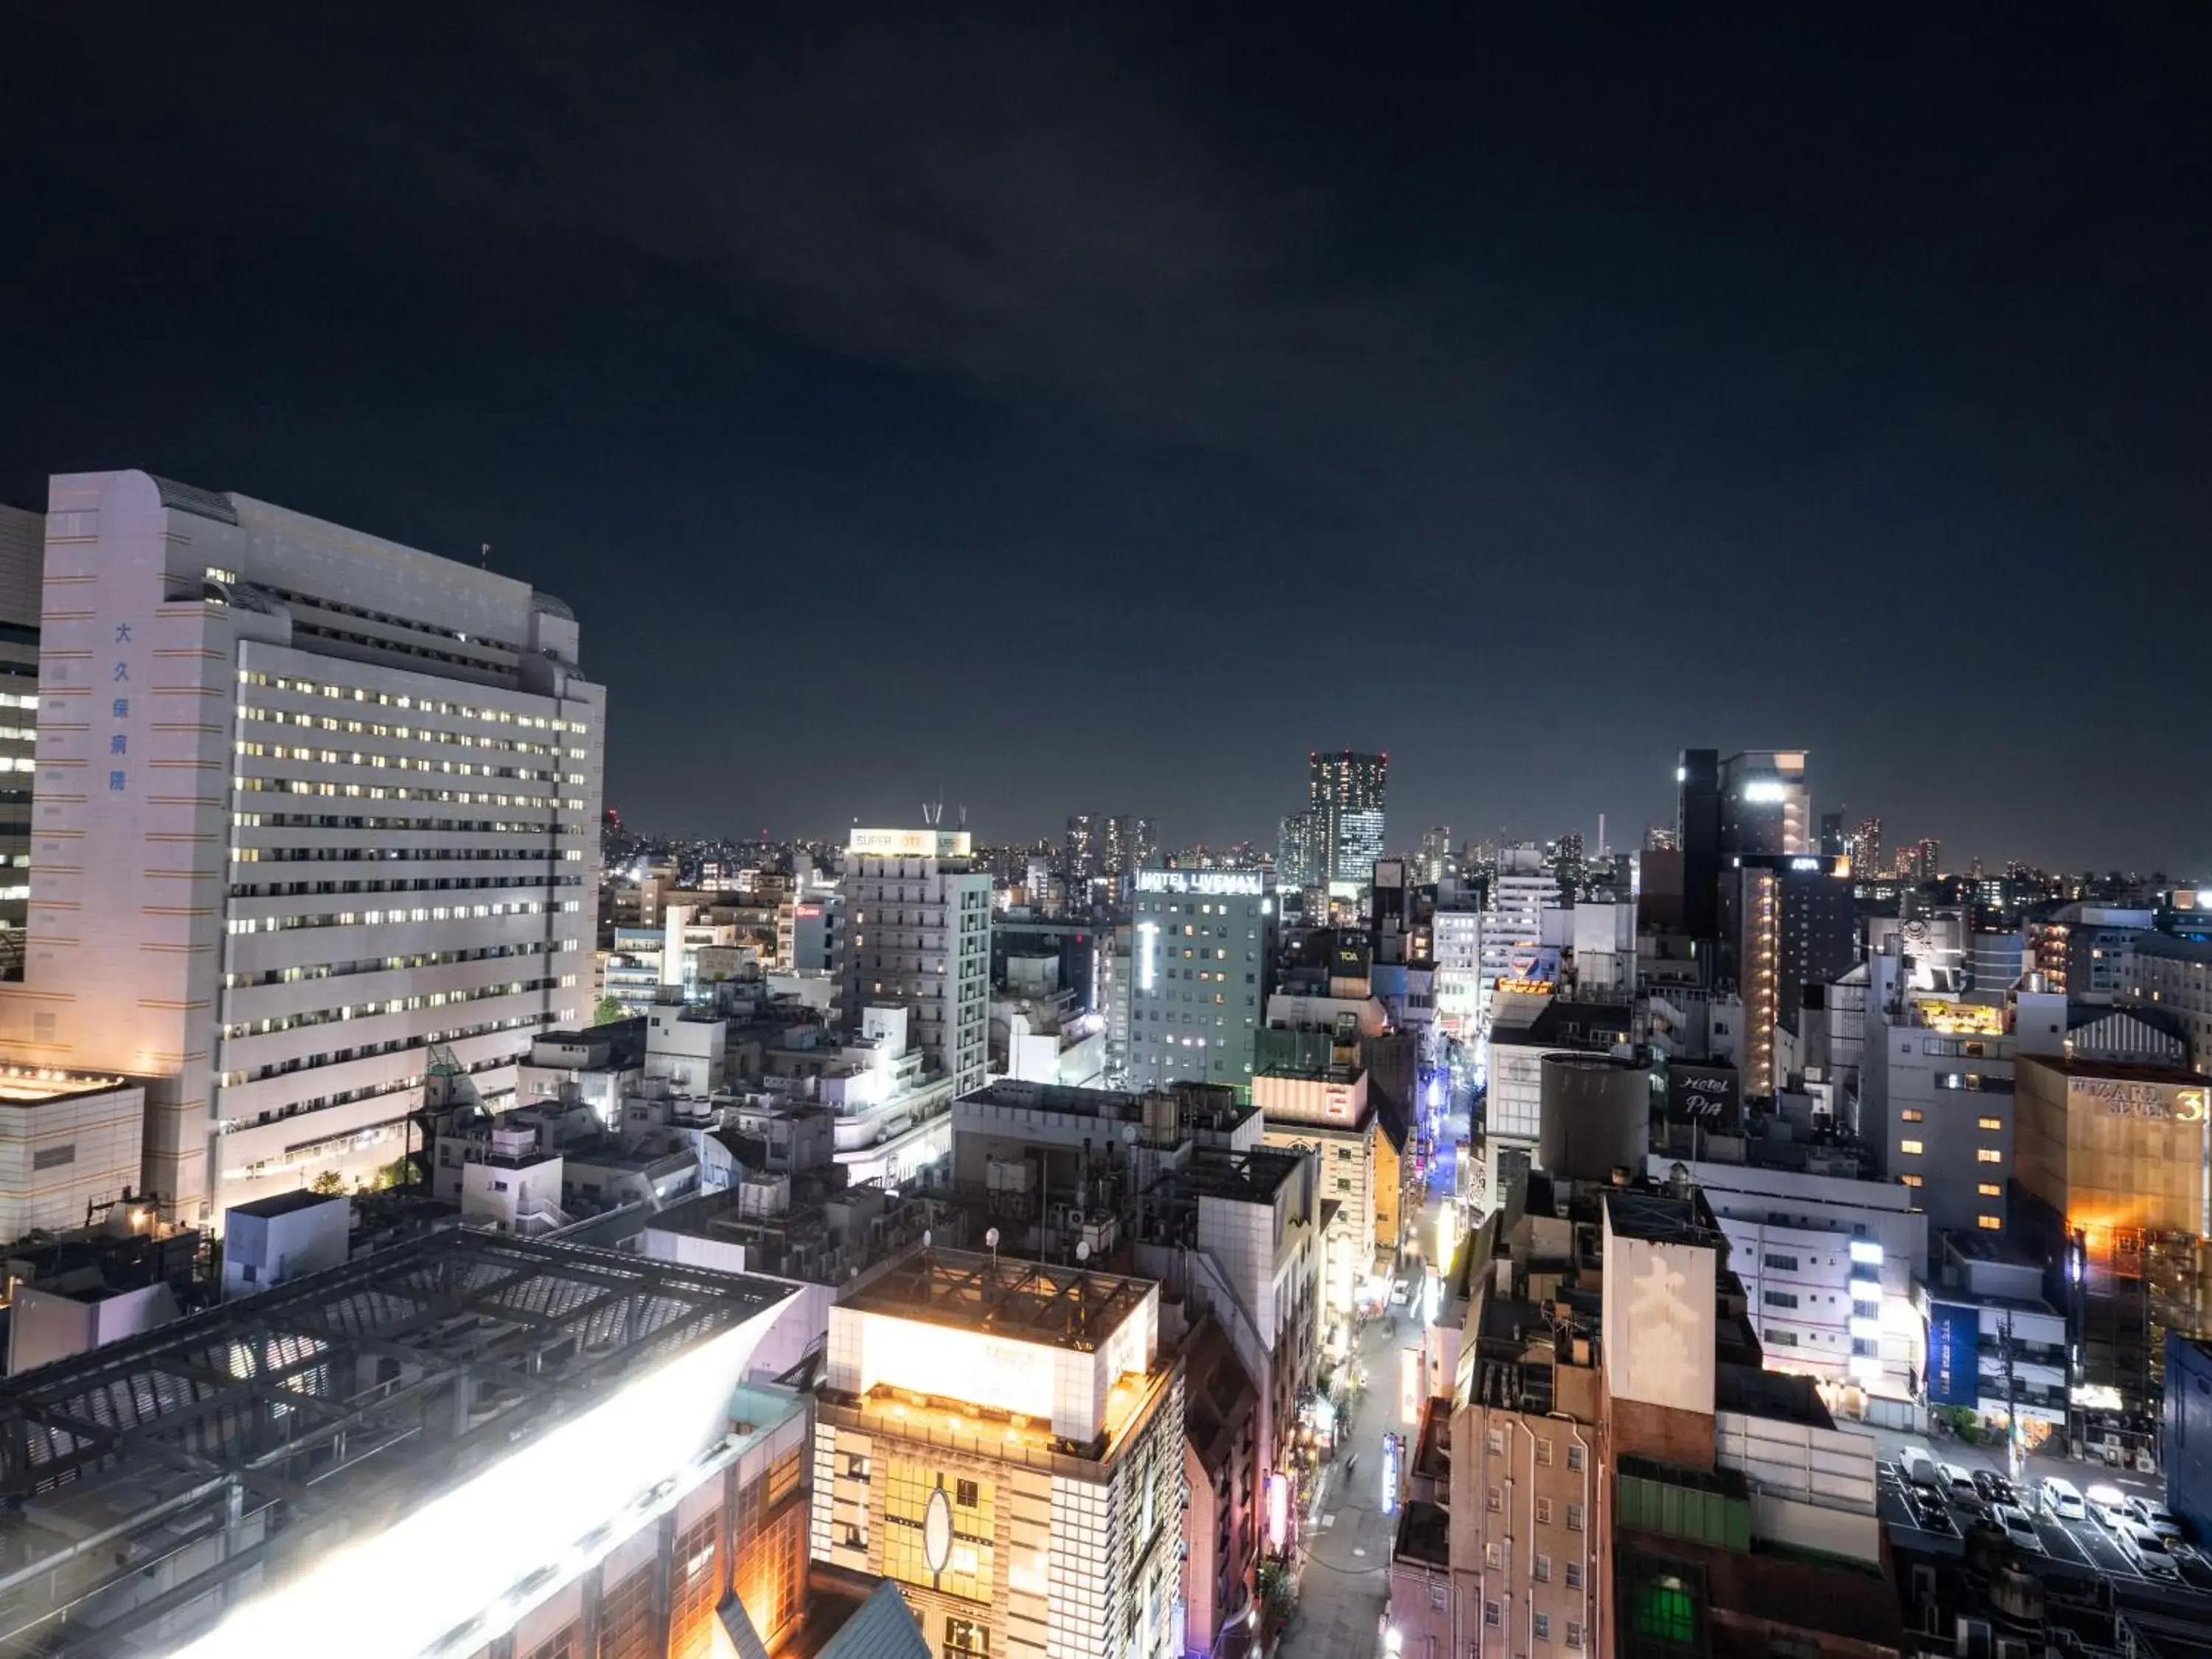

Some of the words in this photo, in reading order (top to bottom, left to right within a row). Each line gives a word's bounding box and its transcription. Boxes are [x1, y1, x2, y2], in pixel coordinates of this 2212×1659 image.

[111, 622, 131, 793] 大久保病院
[1142, 872, 1187, 888] HOTEL
[1191, 873, 1259, 893] LIVEMAX
[1339, 950, 1359, 961] TOA
[2070, 1079, 2162, 1103] WIZARD
[2176, 1089, 2204, 1121] 3
